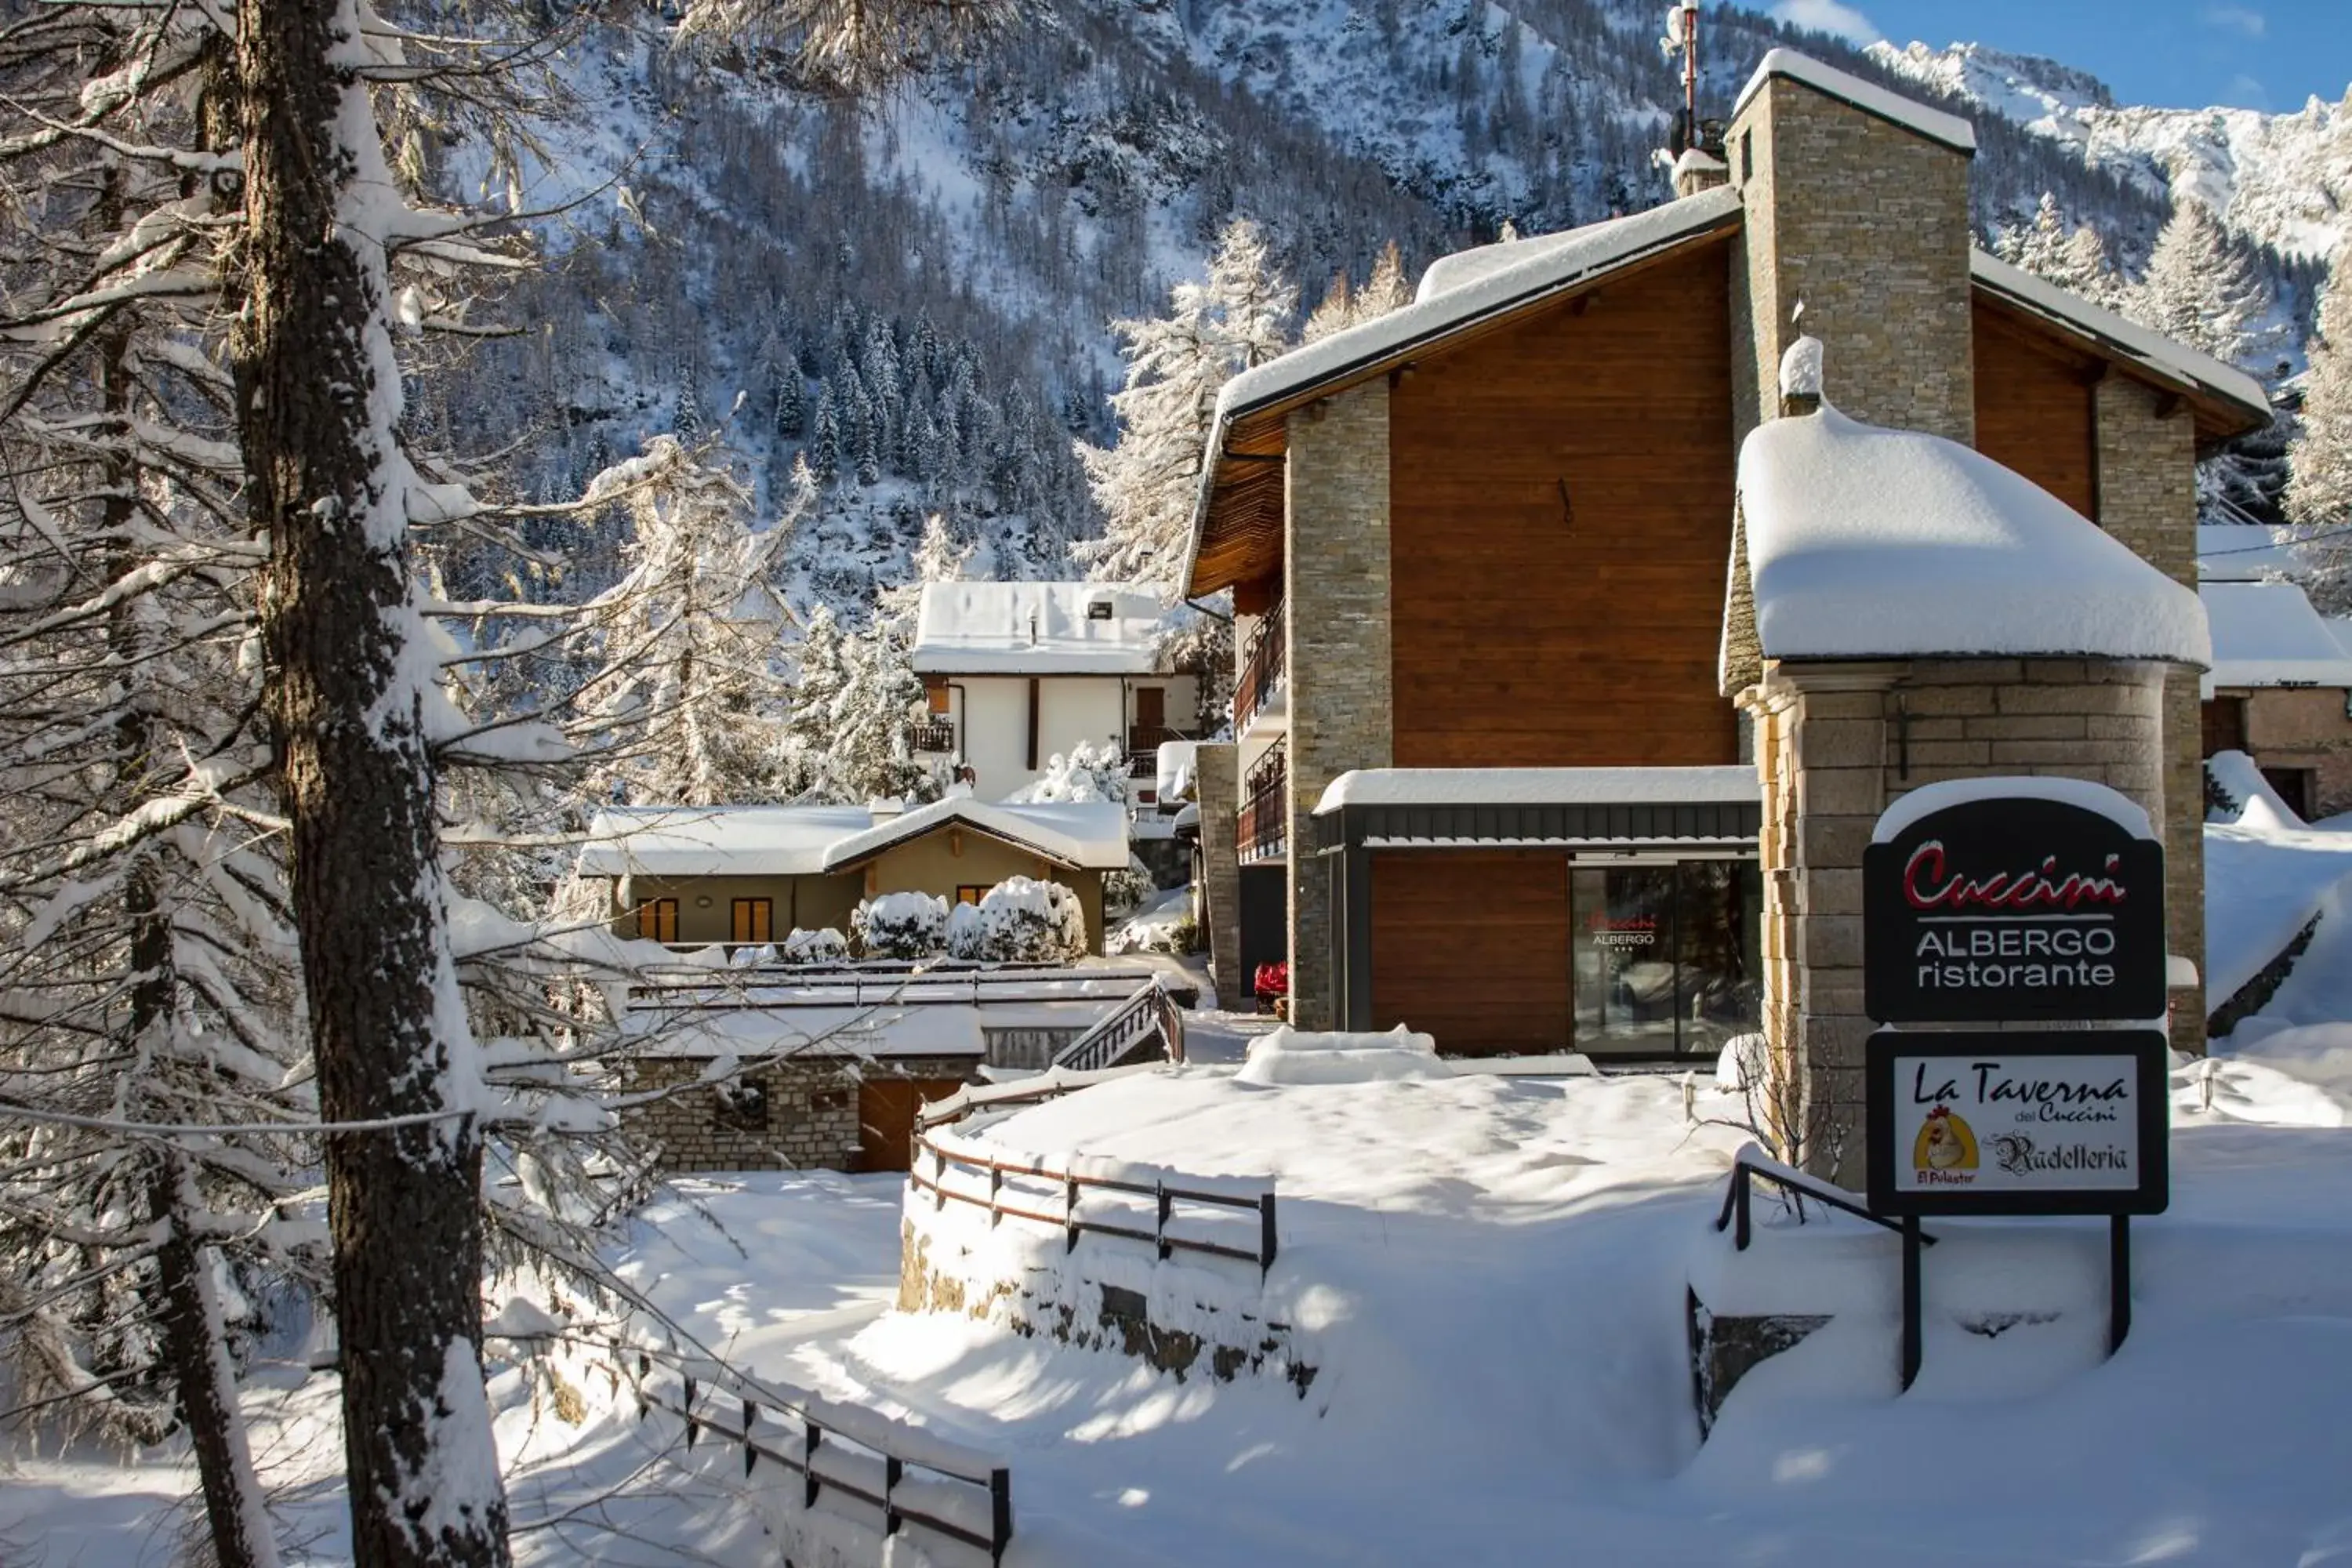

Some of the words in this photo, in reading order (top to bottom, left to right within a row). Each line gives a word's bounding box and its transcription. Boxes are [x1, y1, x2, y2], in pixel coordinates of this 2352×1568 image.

[1904, 840, 2126, 909] Cuccini
[1592, 934, 1655, 946] ALBERGO
[1917, 928, 2116, 956] ALBERGO
[1918, 959, 2116, 988] ristorante
[1914, 1062, 1960, 1104] La
[1972, 1062, 2129, 1103] Taverna
[2014, 1110, 2036, 1123] del
[2039, 1101, 2118, 1123] Cuccini
[1918, 1171, 1928, 1185] El
